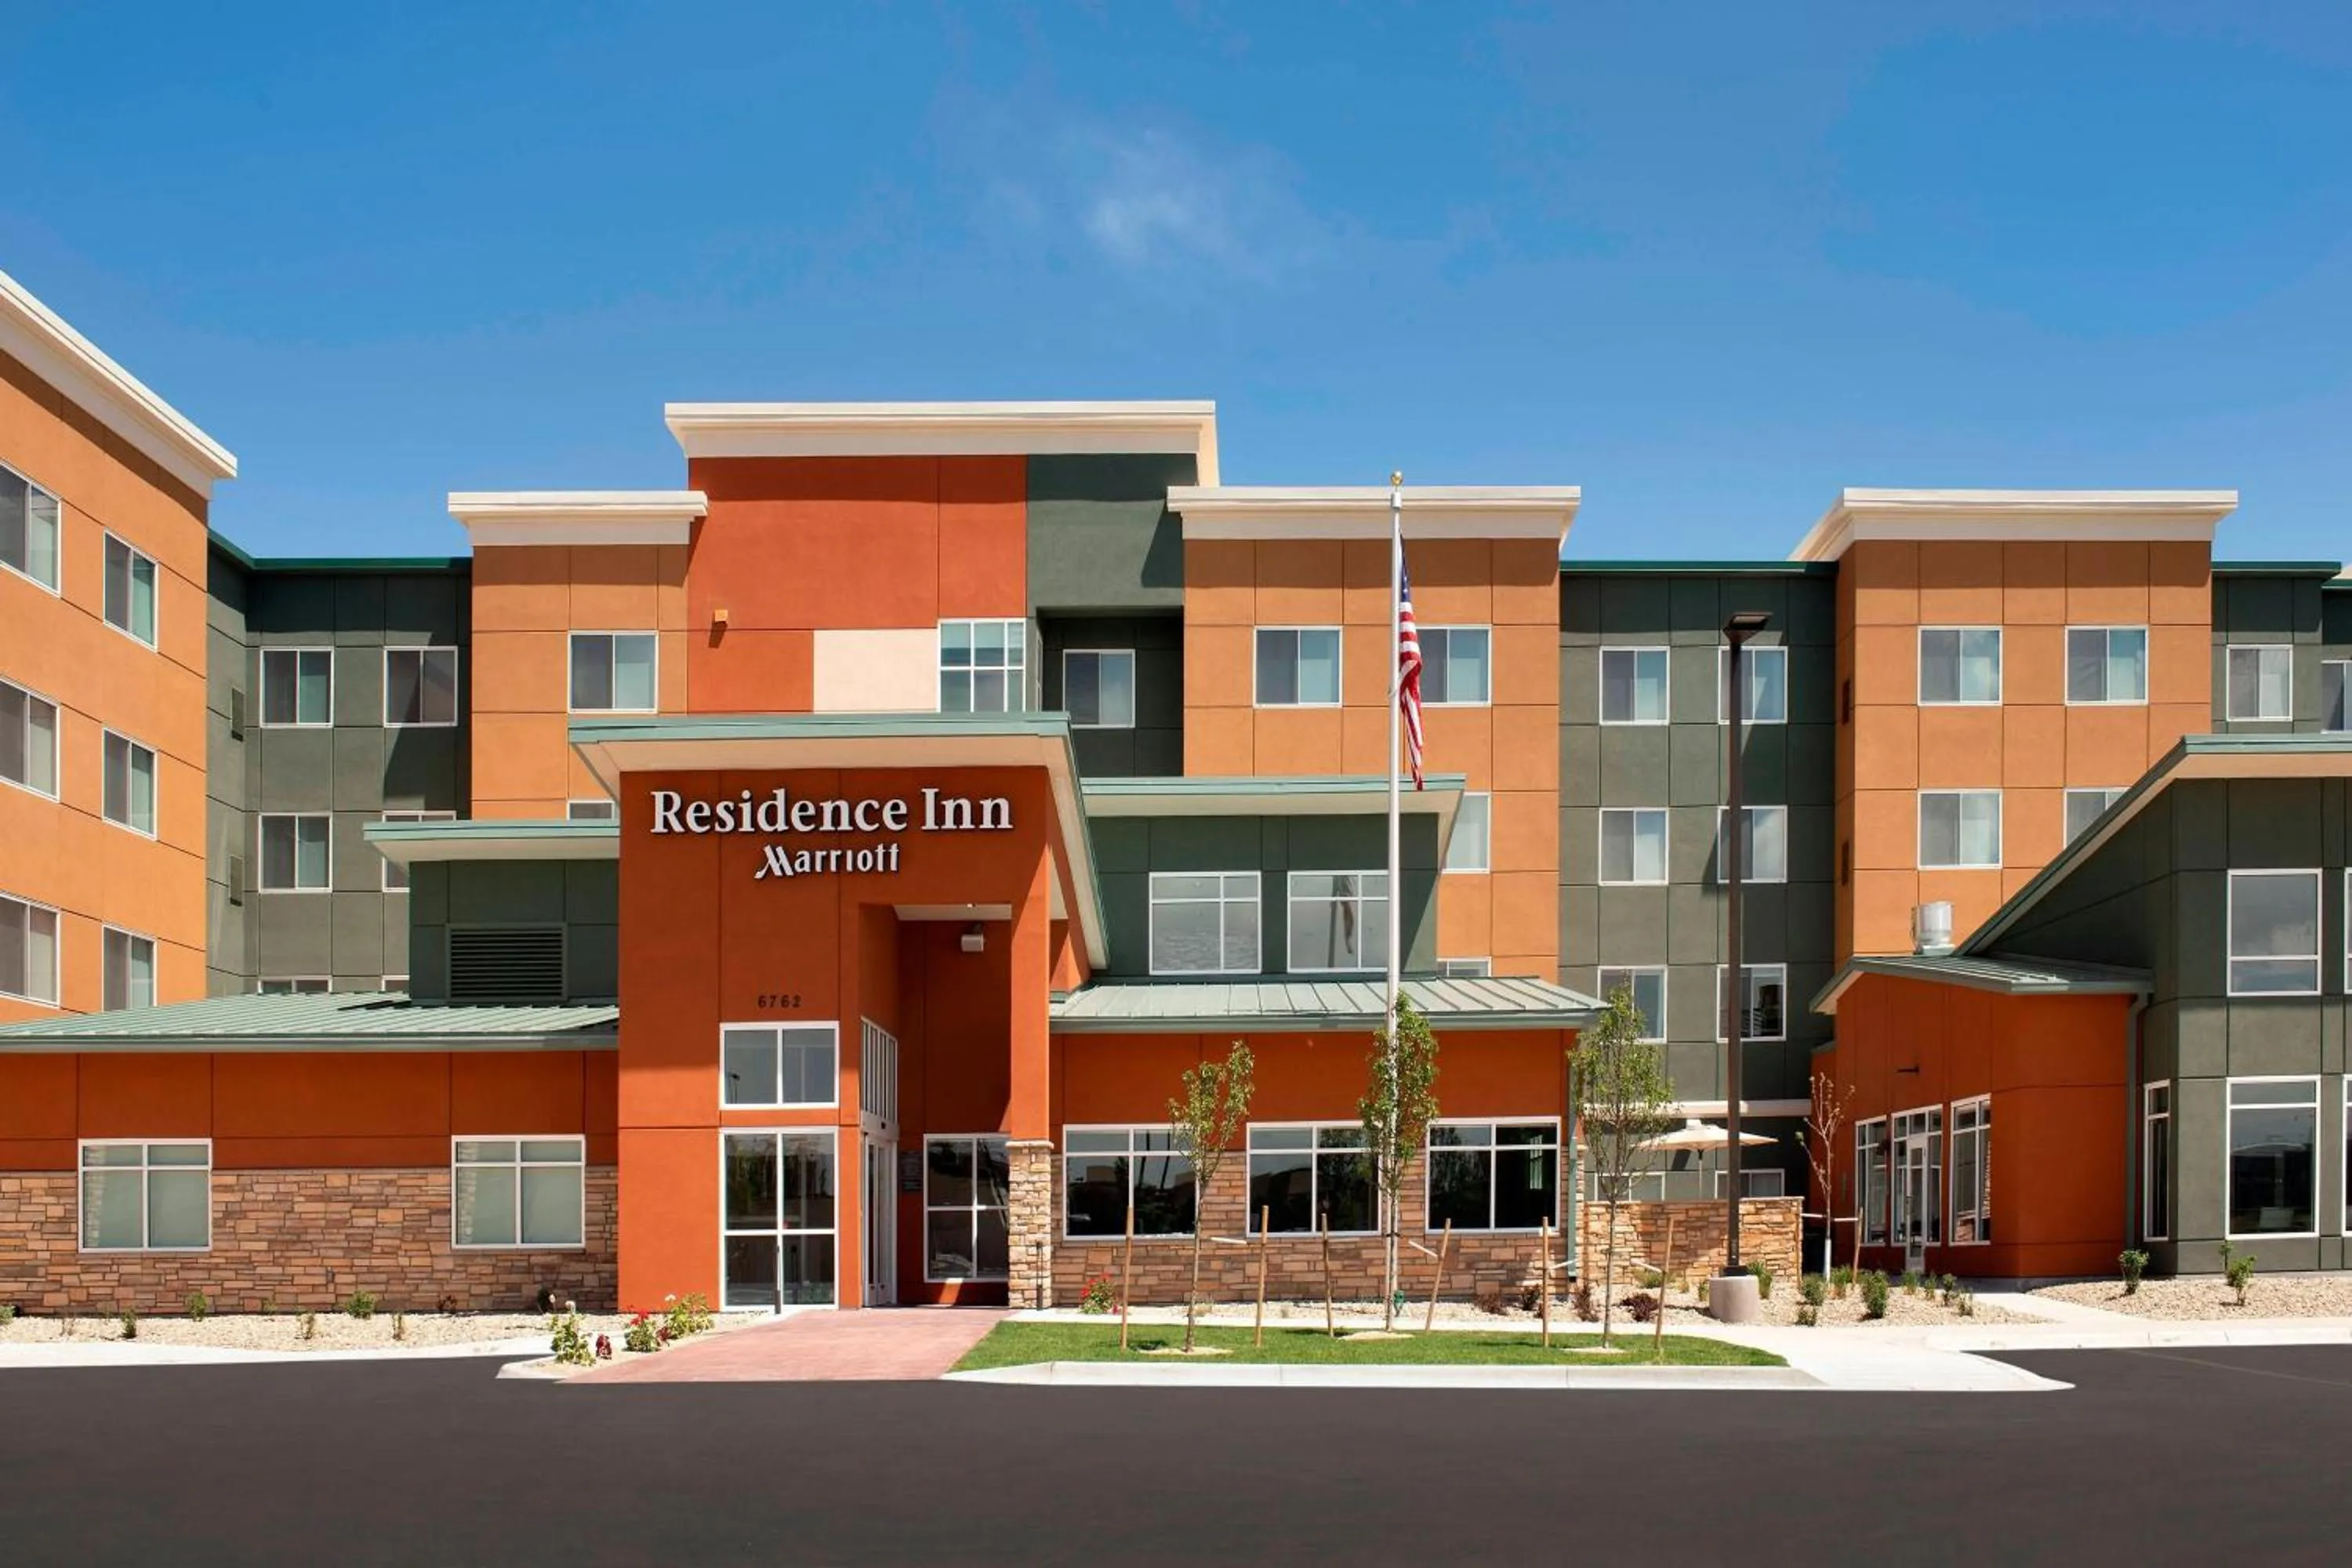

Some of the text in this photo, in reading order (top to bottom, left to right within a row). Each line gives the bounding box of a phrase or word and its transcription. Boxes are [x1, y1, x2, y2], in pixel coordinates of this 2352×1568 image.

[650, 787, 1013, 833] Residence Inn
[754, 843, 899, 879] Marriott
[757, 994, 801, 1009] 6762
